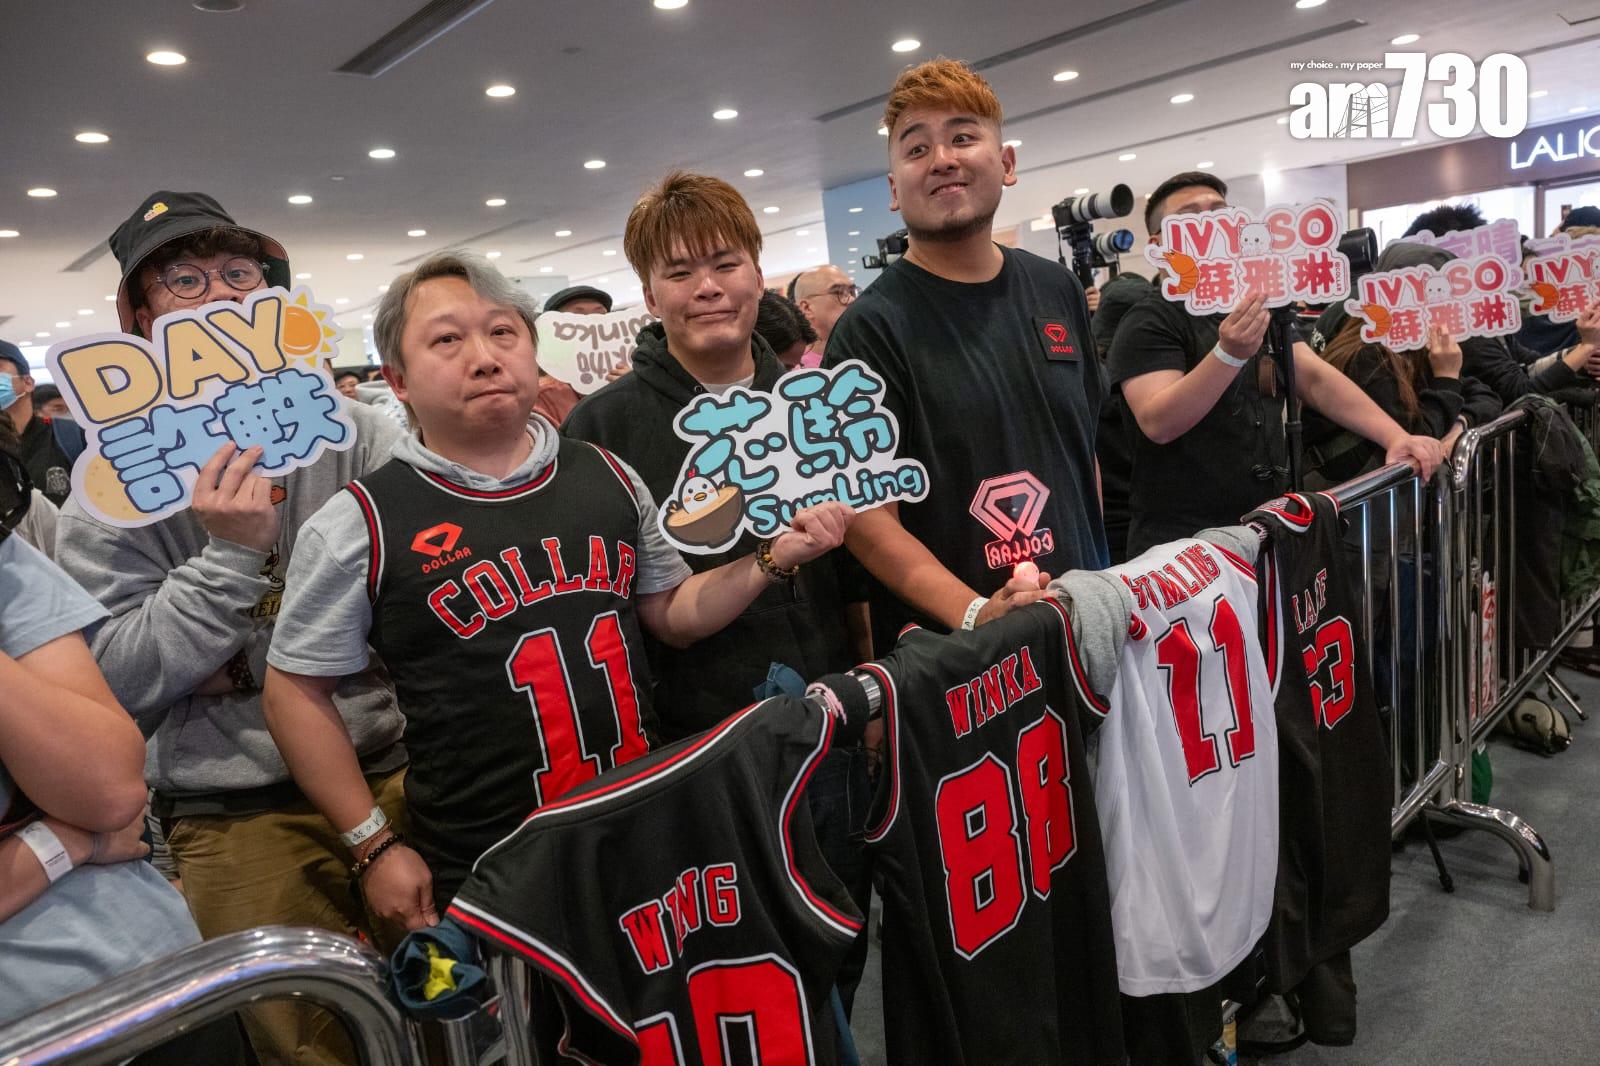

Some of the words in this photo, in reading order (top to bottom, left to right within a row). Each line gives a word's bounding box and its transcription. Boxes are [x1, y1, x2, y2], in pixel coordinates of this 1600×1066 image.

[1170, 216, 1247, 257] IVY
[1267, 207, 1334, 250] SO
[1535, 250, 1597, 283] IVY
[1195, 250, 1335, 305] 蘇雅琳
[1367, 271, 1430, 307] IVY
[1448, 260, 1505, 296] SO
[1389, 294, 1508, 346] 蘇雅琳
[58, 296, 287, 424] DAY
[422, 546, 472, 574] DOLLAR
[427, 535, 636, 639] COLLAR
[505, 610, 650, 807] 11
[945, 645, 1042, 739] WINKA
[1154, 593, 1256, 787] 11
[935, 704, 1078, 961] 88
